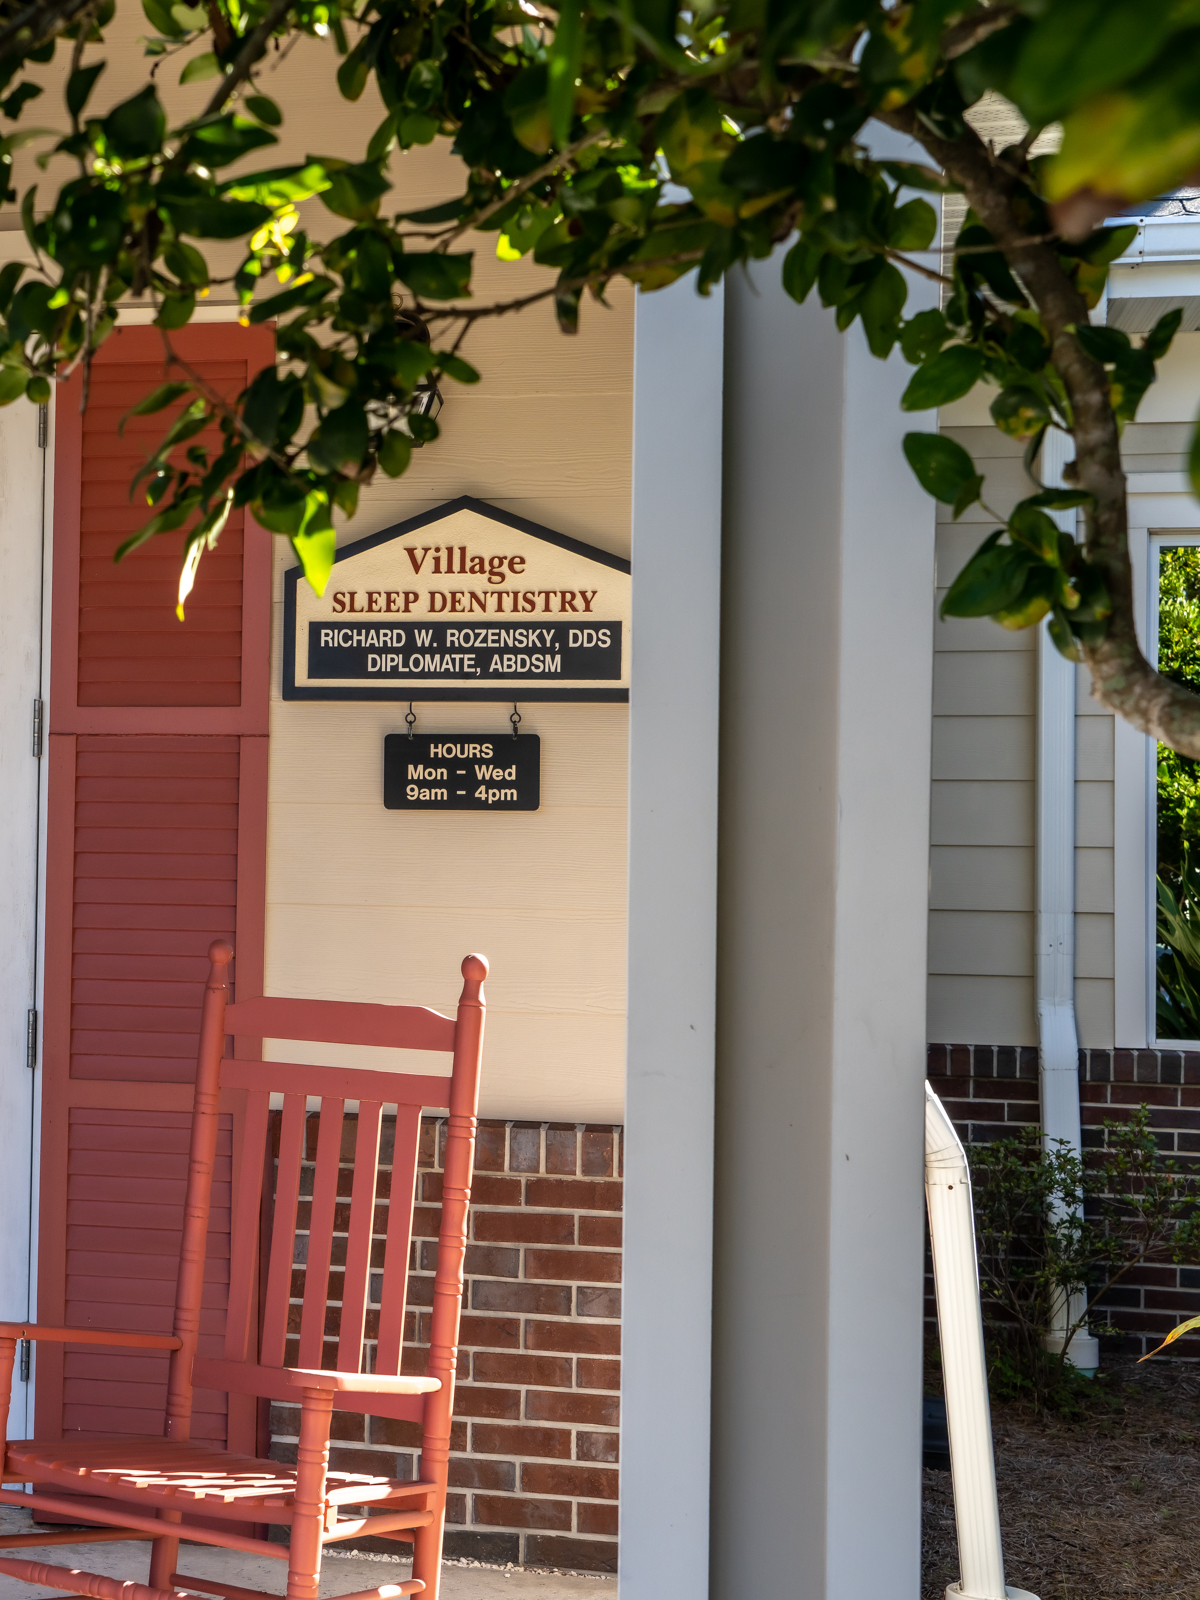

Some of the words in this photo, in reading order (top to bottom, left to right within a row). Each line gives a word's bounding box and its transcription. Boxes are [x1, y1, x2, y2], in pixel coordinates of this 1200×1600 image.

[404, 546, 526, 585] Village
[332, 591, 420, 613] SLEEP
[428, 590, 598, 613] DENTISTRY
[320, 629, 406, 647] RICHARD
[414, 629, 437, 647] W.
[446, 629, 560, 651] ROZENSKY,
[568, 629, 611, 648] DDS
[367, 654, 481, 676] DIPLOMATE,
[489, 654, 561, 673] ABDSM
[429, 743, 494, 758] HOURS
[407, 765, 448, 781] Mon
[474, 765, 517, 781] Wed
[406, 785, 448, 801] 9am
[474, 785, 518, 802] 4pm
